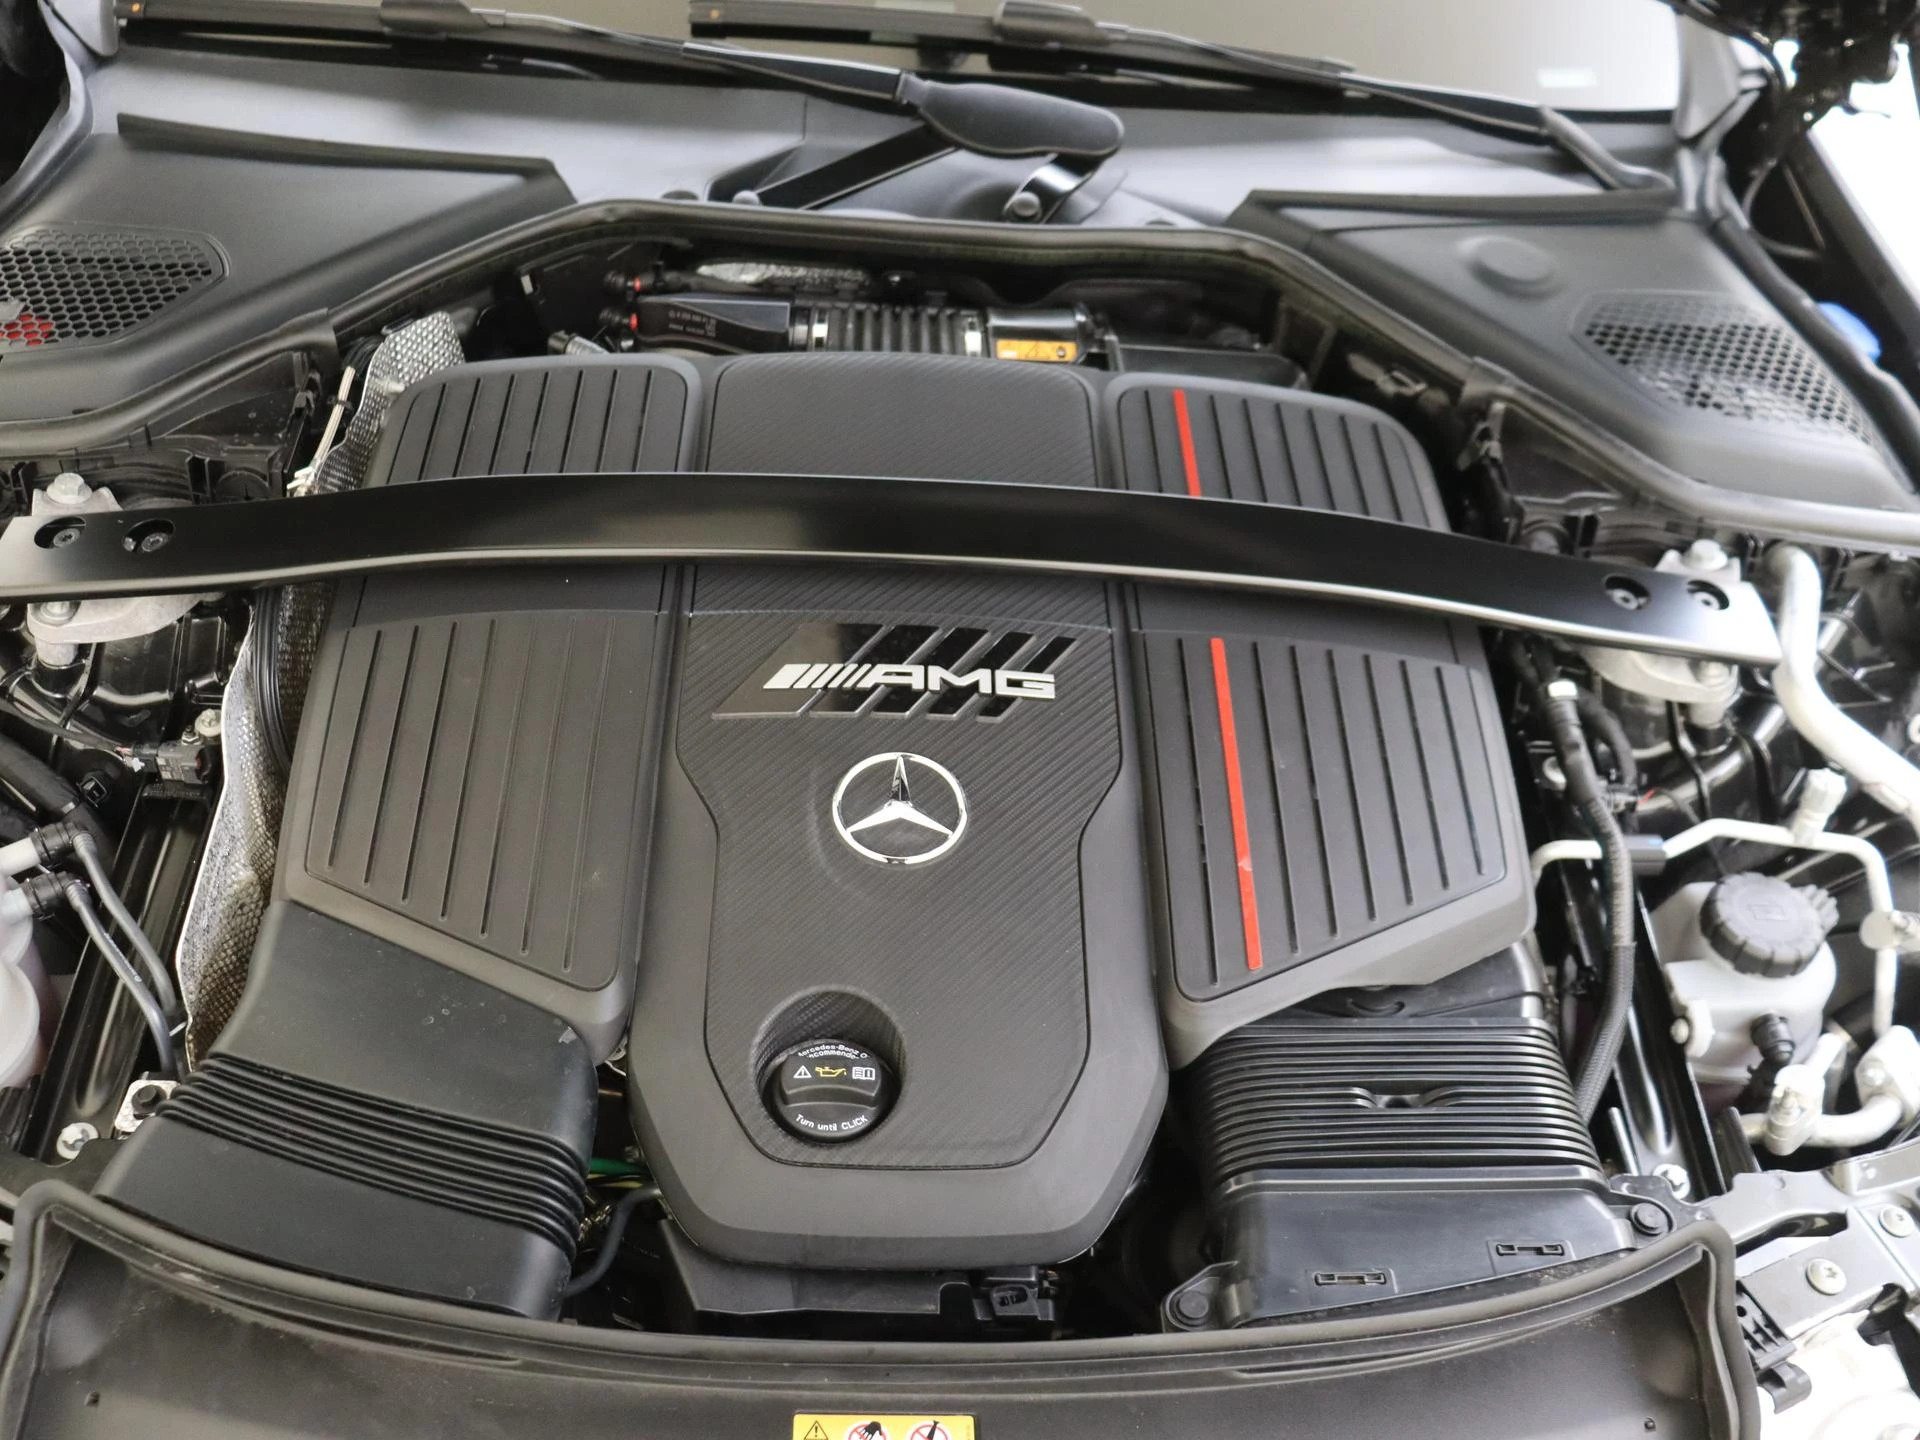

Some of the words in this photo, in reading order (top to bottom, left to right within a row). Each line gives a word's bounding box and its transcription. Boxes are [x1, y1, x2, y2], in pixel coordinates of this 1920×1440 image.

[856, 663, 1056, 699] AMG
[796, 1114, 814, 1128] Turn
[818, 1123, 837, 1131] until
[841, 1115, 868, 1130] CLICK
